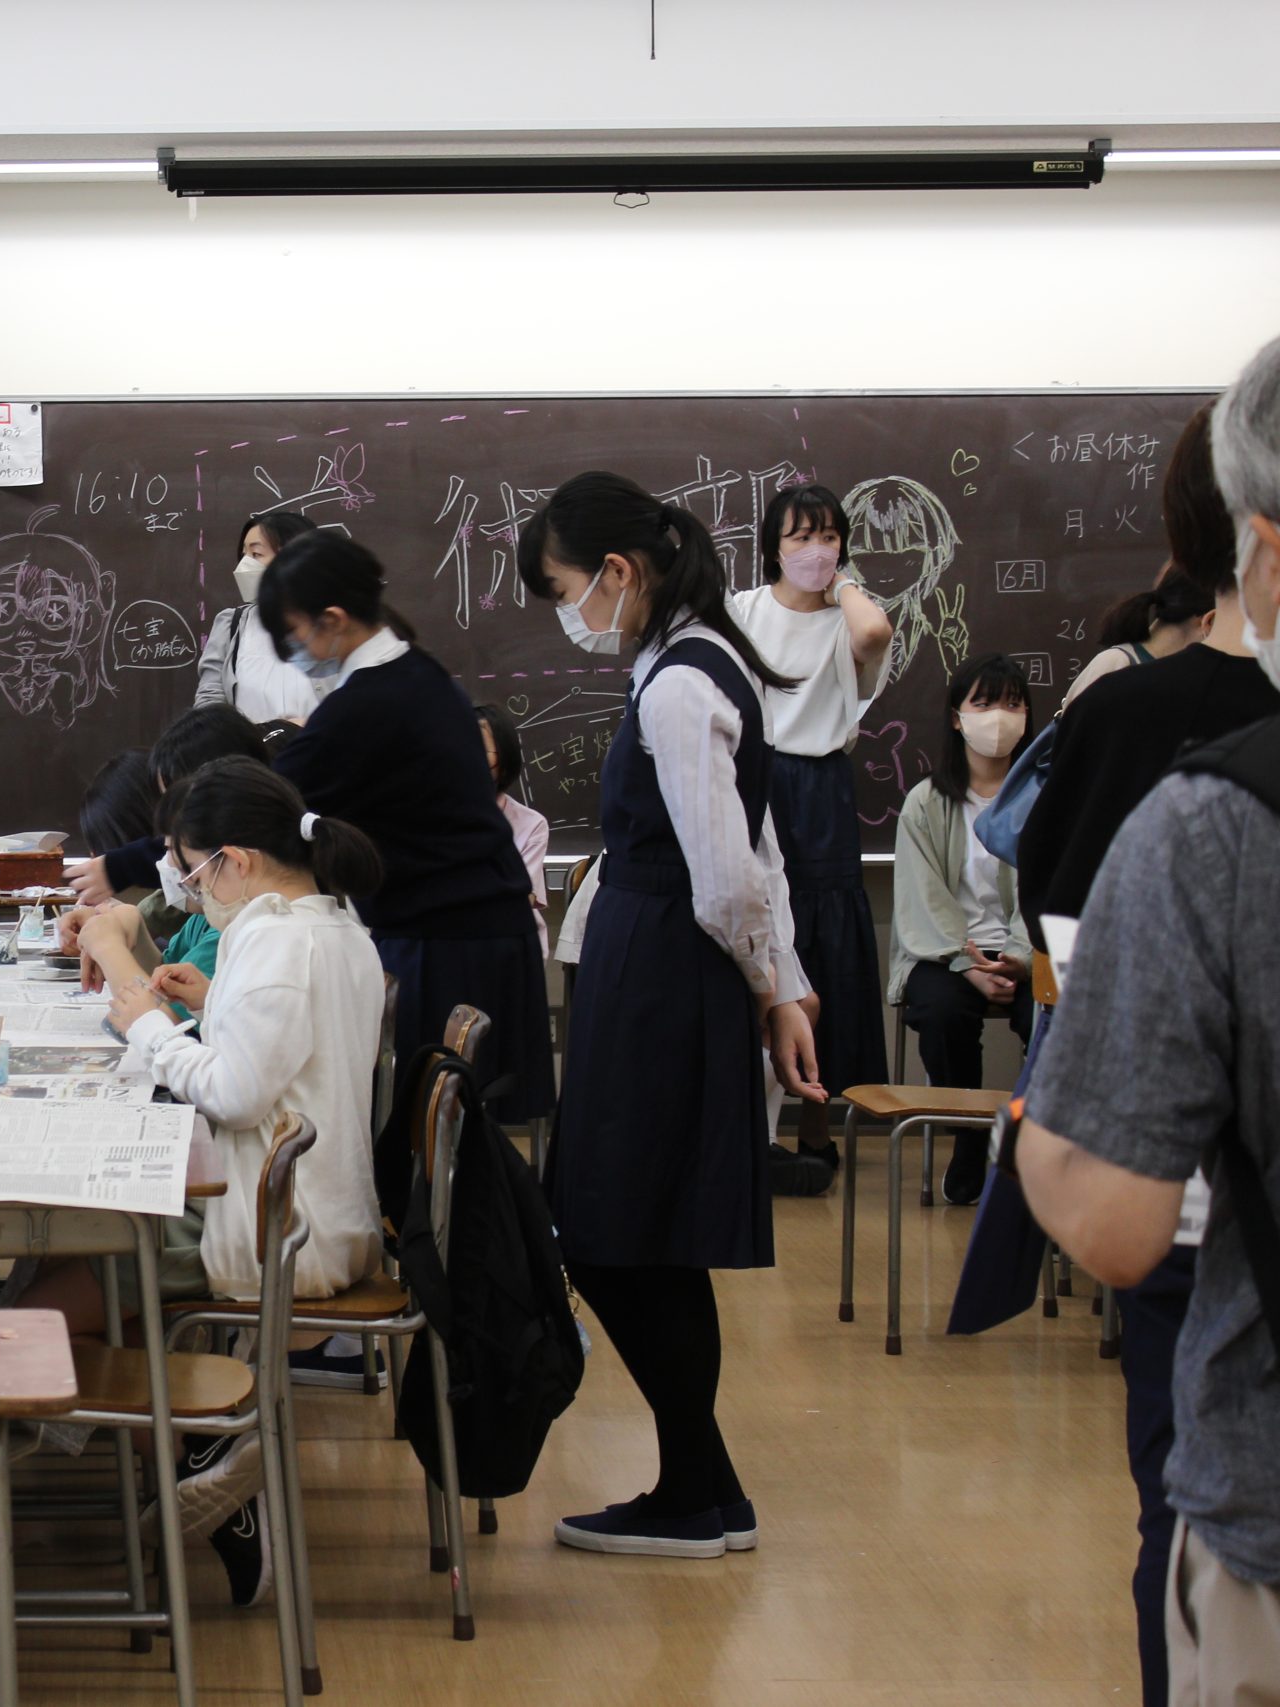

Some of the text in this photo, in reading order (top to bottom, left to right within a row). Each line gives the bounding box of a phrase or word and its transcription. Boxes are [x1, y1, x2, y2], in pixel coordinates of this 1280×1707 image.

[75, 472, 169, 514] 16:10
[144, 511, 184, 532] まで
[1002, 562, 1038, 589] 6月
[118, 616, 165, 642] 七宝
[1056, 618, 1087, 641] 26
